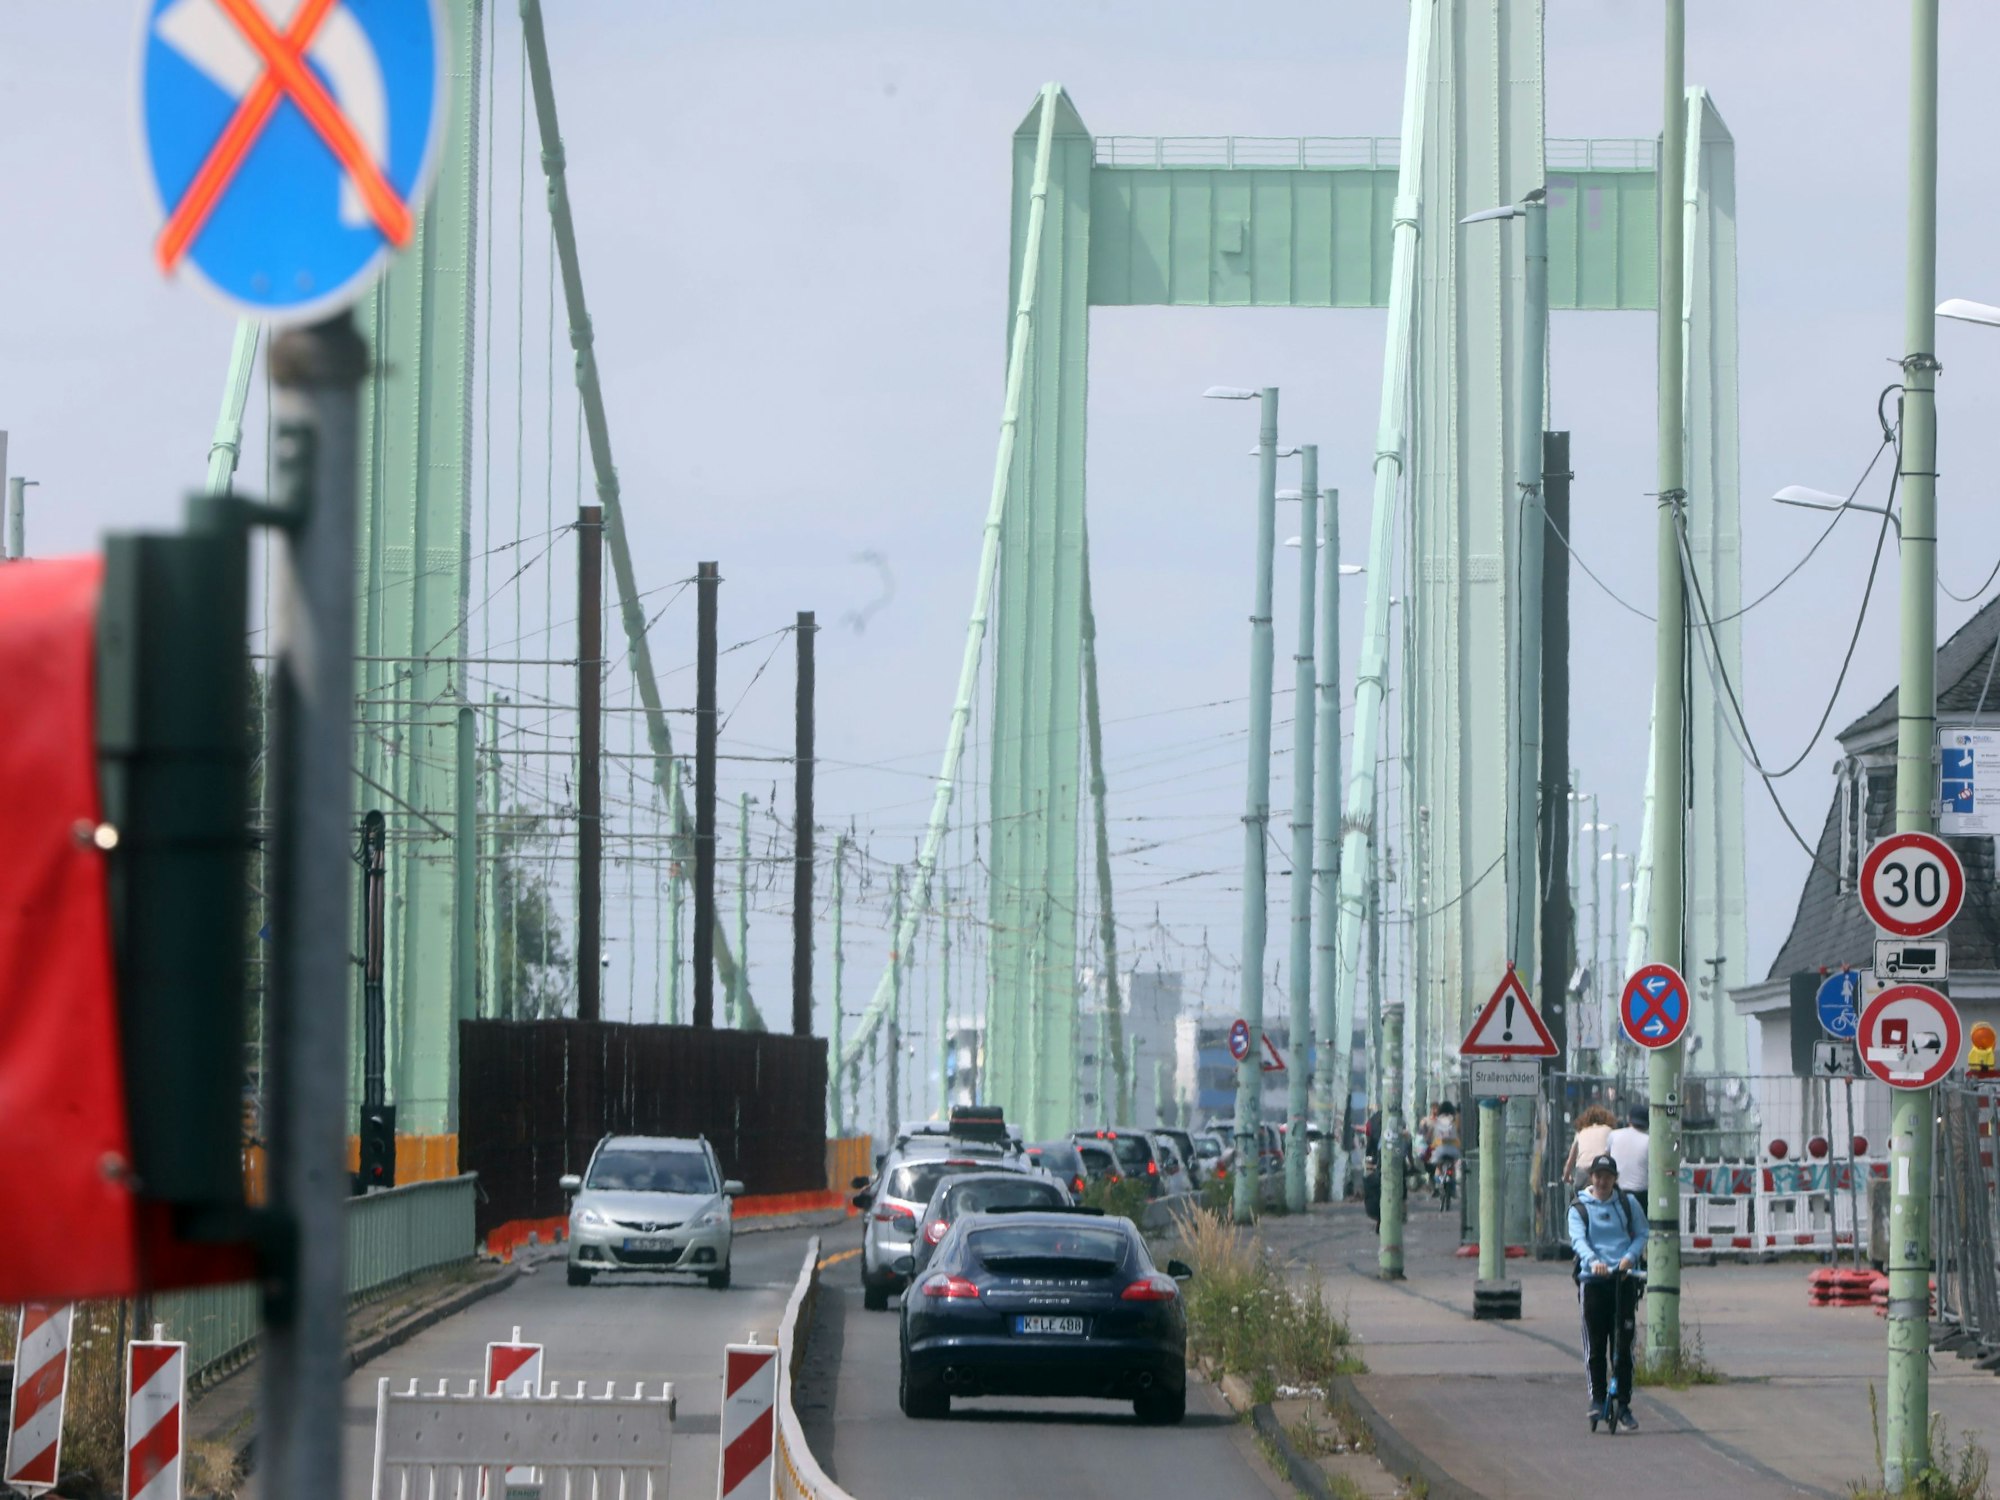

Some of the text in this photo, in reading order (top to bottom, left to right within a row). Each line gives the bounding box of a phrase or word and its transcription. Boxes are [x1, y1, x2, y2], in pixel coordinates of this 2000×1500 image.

[1882, 861, 1940, 908] 30
[1475, 1071, 1535, 1083] Straßenschäden
[1024, 1316, 1032, 1330] K
